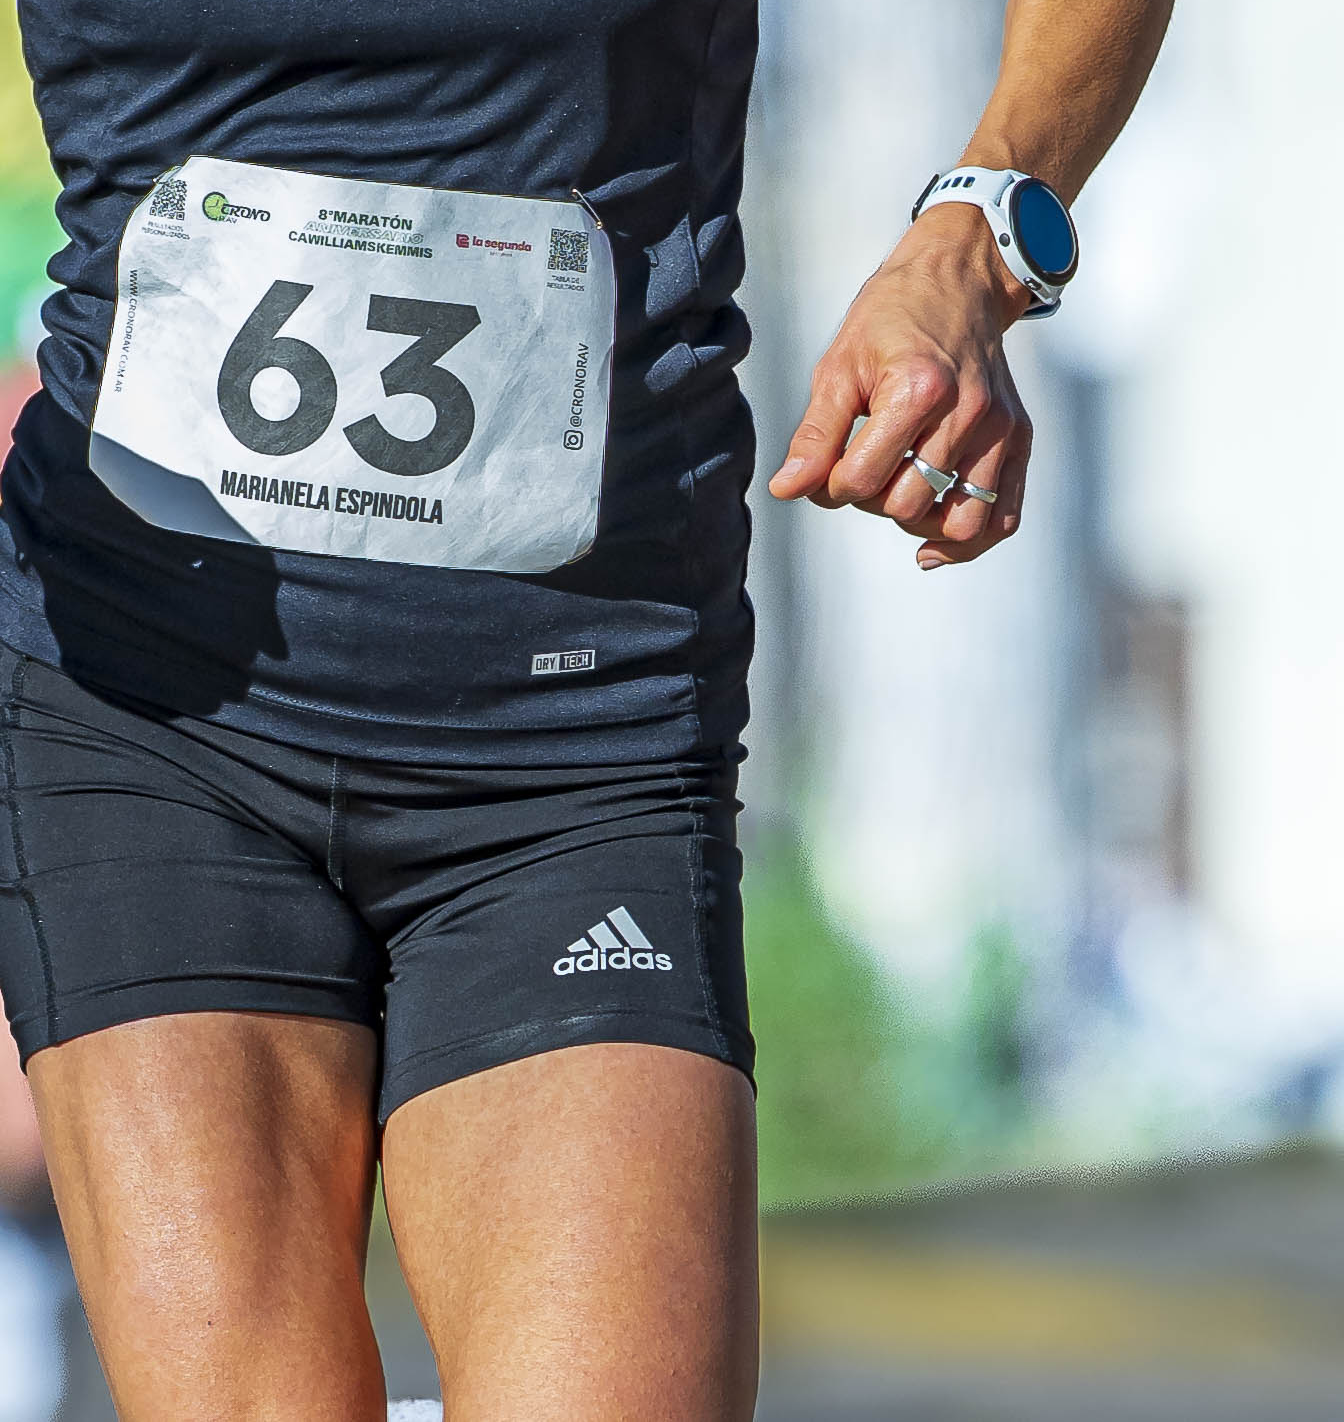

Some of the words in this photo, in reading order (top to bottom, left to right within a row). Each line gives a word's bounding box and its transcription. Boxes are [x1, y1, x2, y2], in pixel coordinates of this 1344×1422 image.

[472, 236, 483, 247] la
[484, 239, 532, 252] segunda
[217, 280, 482, 477] 63
[569, 342, 589, 428] @CRONORAV
[220, 469, 330, 511] MARIANELA
[334, 487, 444, 525] ESPINDOLA
[536, 657, 556, 670] DRY
[563, 653, 589, 669] TECH
[552, 946, 673, 976] adidas
